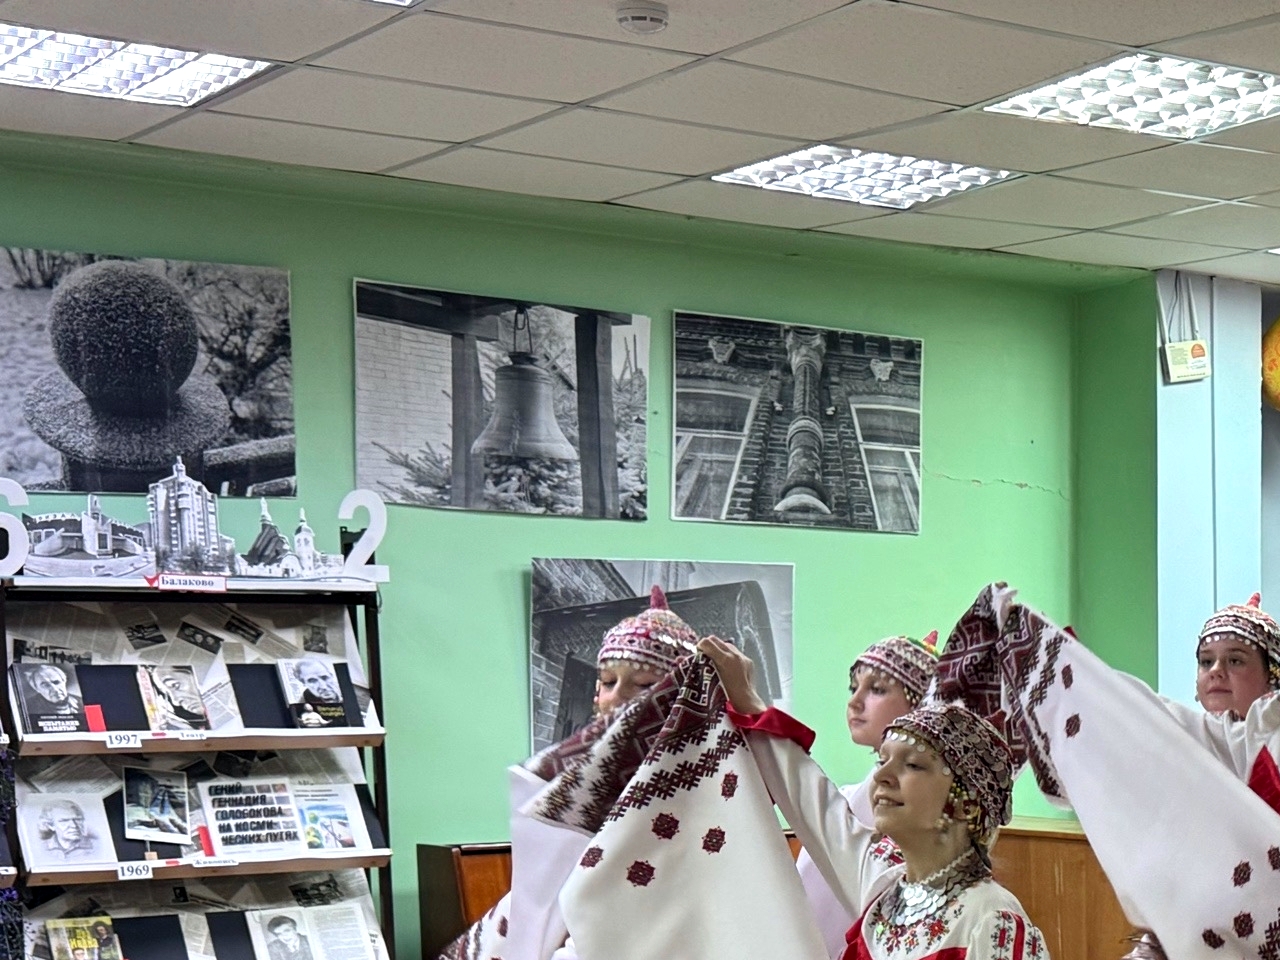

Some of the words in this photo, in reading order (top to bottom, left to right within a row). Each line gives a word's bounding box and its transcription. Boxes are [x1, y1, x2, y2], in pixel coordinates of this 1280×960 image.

[338, 489, 390, 583] 2
[161, 576, 214, 587] Балаково
[108, 734, 139, 745] 1997
[208, 782, 242, 796] ГЕНИЙ
[211, 794, 267, 808] ГЕННАДИЯ
[215, 806, 284, 821] ГОЛОБОКОВА
[218, 822, 233, 834] НА
[119, 865, 149, 877] 1969
